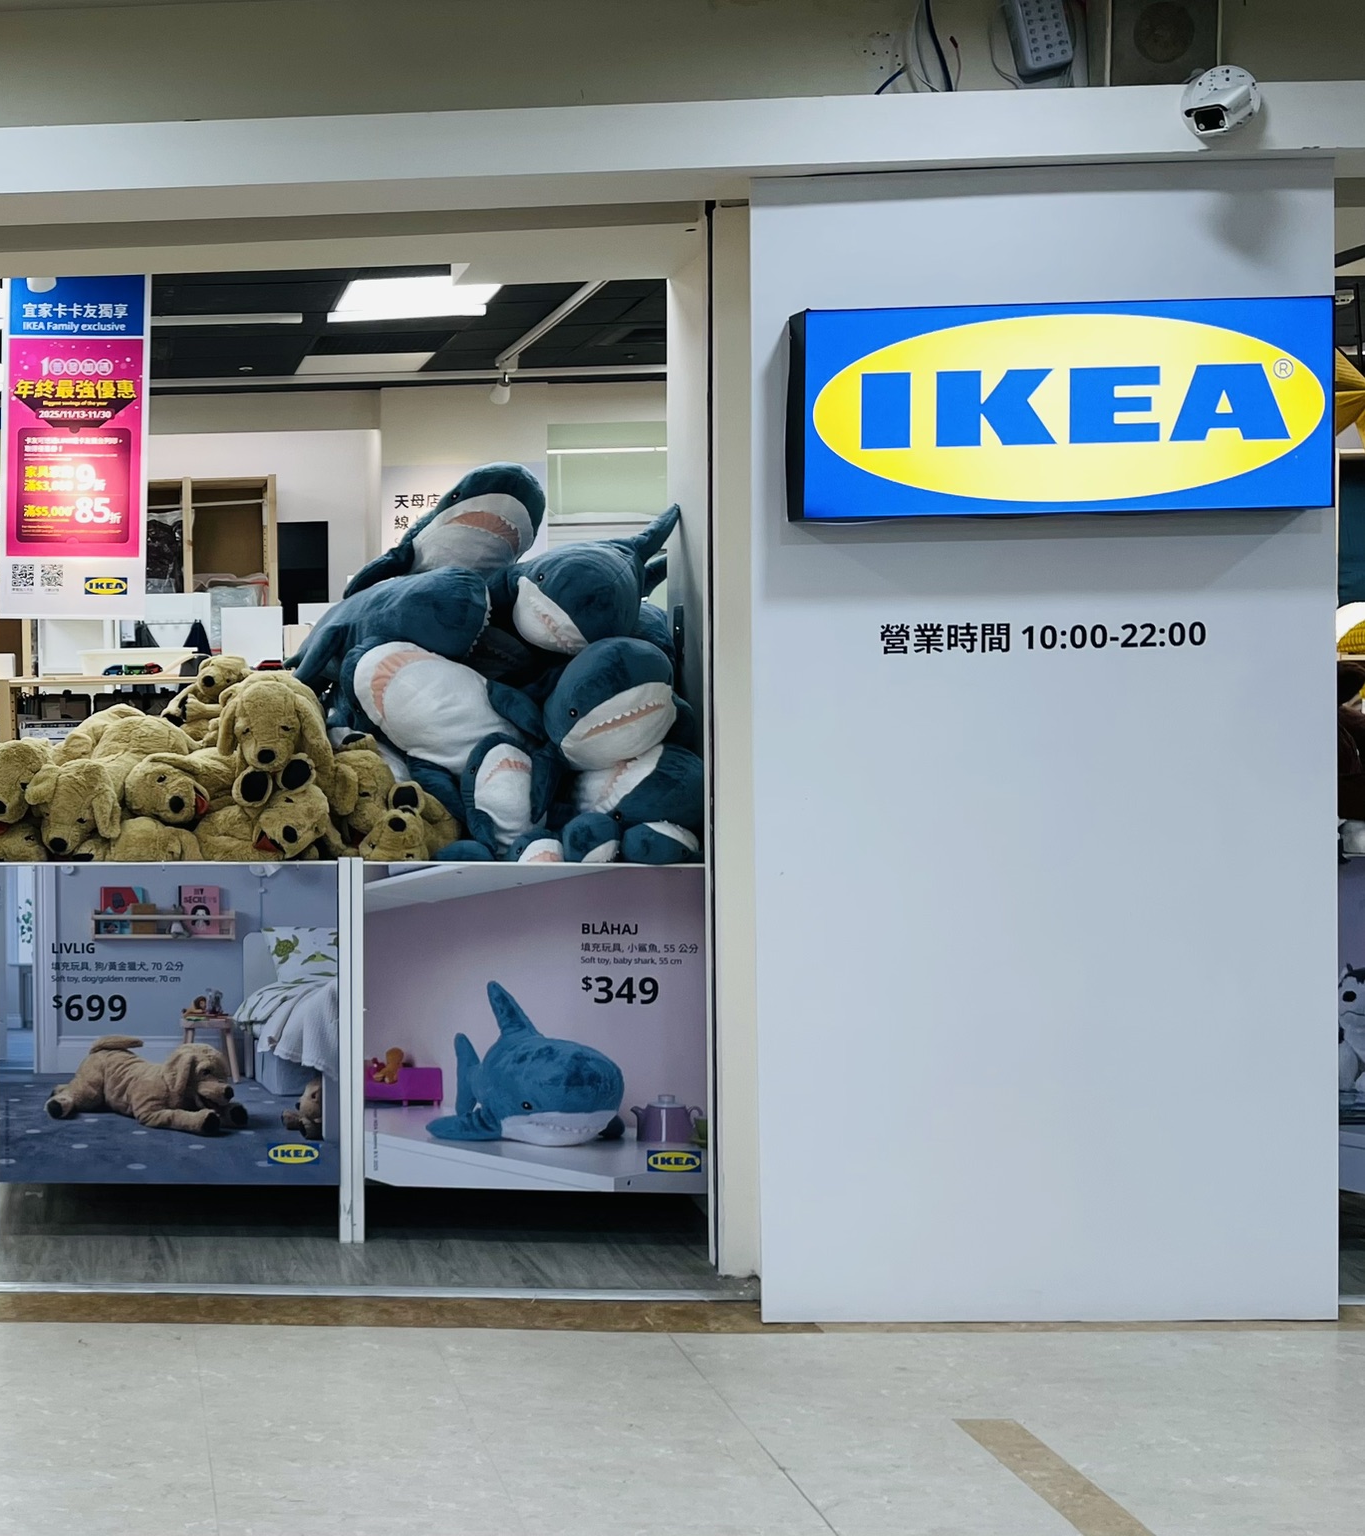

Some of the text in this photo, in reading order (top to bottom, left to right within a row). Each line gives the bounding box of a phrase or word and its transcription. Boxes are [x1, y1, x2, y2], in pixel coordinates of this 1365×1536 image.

[22, 302, 129, 319] 宜家卡卡友獨享
[23, 321, 127, 334] IKEA Family exclusive
[15, 378, 138, 400] 年終最強優惠
[860, 362, 1292, 450] IKEA
[394, 493, 441, 509] 天母店
[880, 621, 1208, 655] 營業時間 10:00-22:00
[581, 920, 639, 936] BLÅHAJ
[51, 942, 96, 954] LIVLIG
[580, 942, 699, 954] 填充玩具, 小鯊魚, 55 公分
[51, 961, 92, 973] 填充玩具,
[151, 962, 163, 971] 70
[164, 961, 184, 972] 公分
[580, 956, 596, 965] Soft
[597, 956, 612, 966] toy,
[613, 956, 633, 966] baby
[633, 956, 658, 966] shark,
[659, 956, 669, 965] 55
[51, 974, 66, 983] Soft
[66, 975, 81, 984] toy,
[81, 974, 124, 985] dog/golden
[158, 974, 169, 983] 70
[581, 975, 660, 1005] $349
[52, 993, 127, 1022] $699
